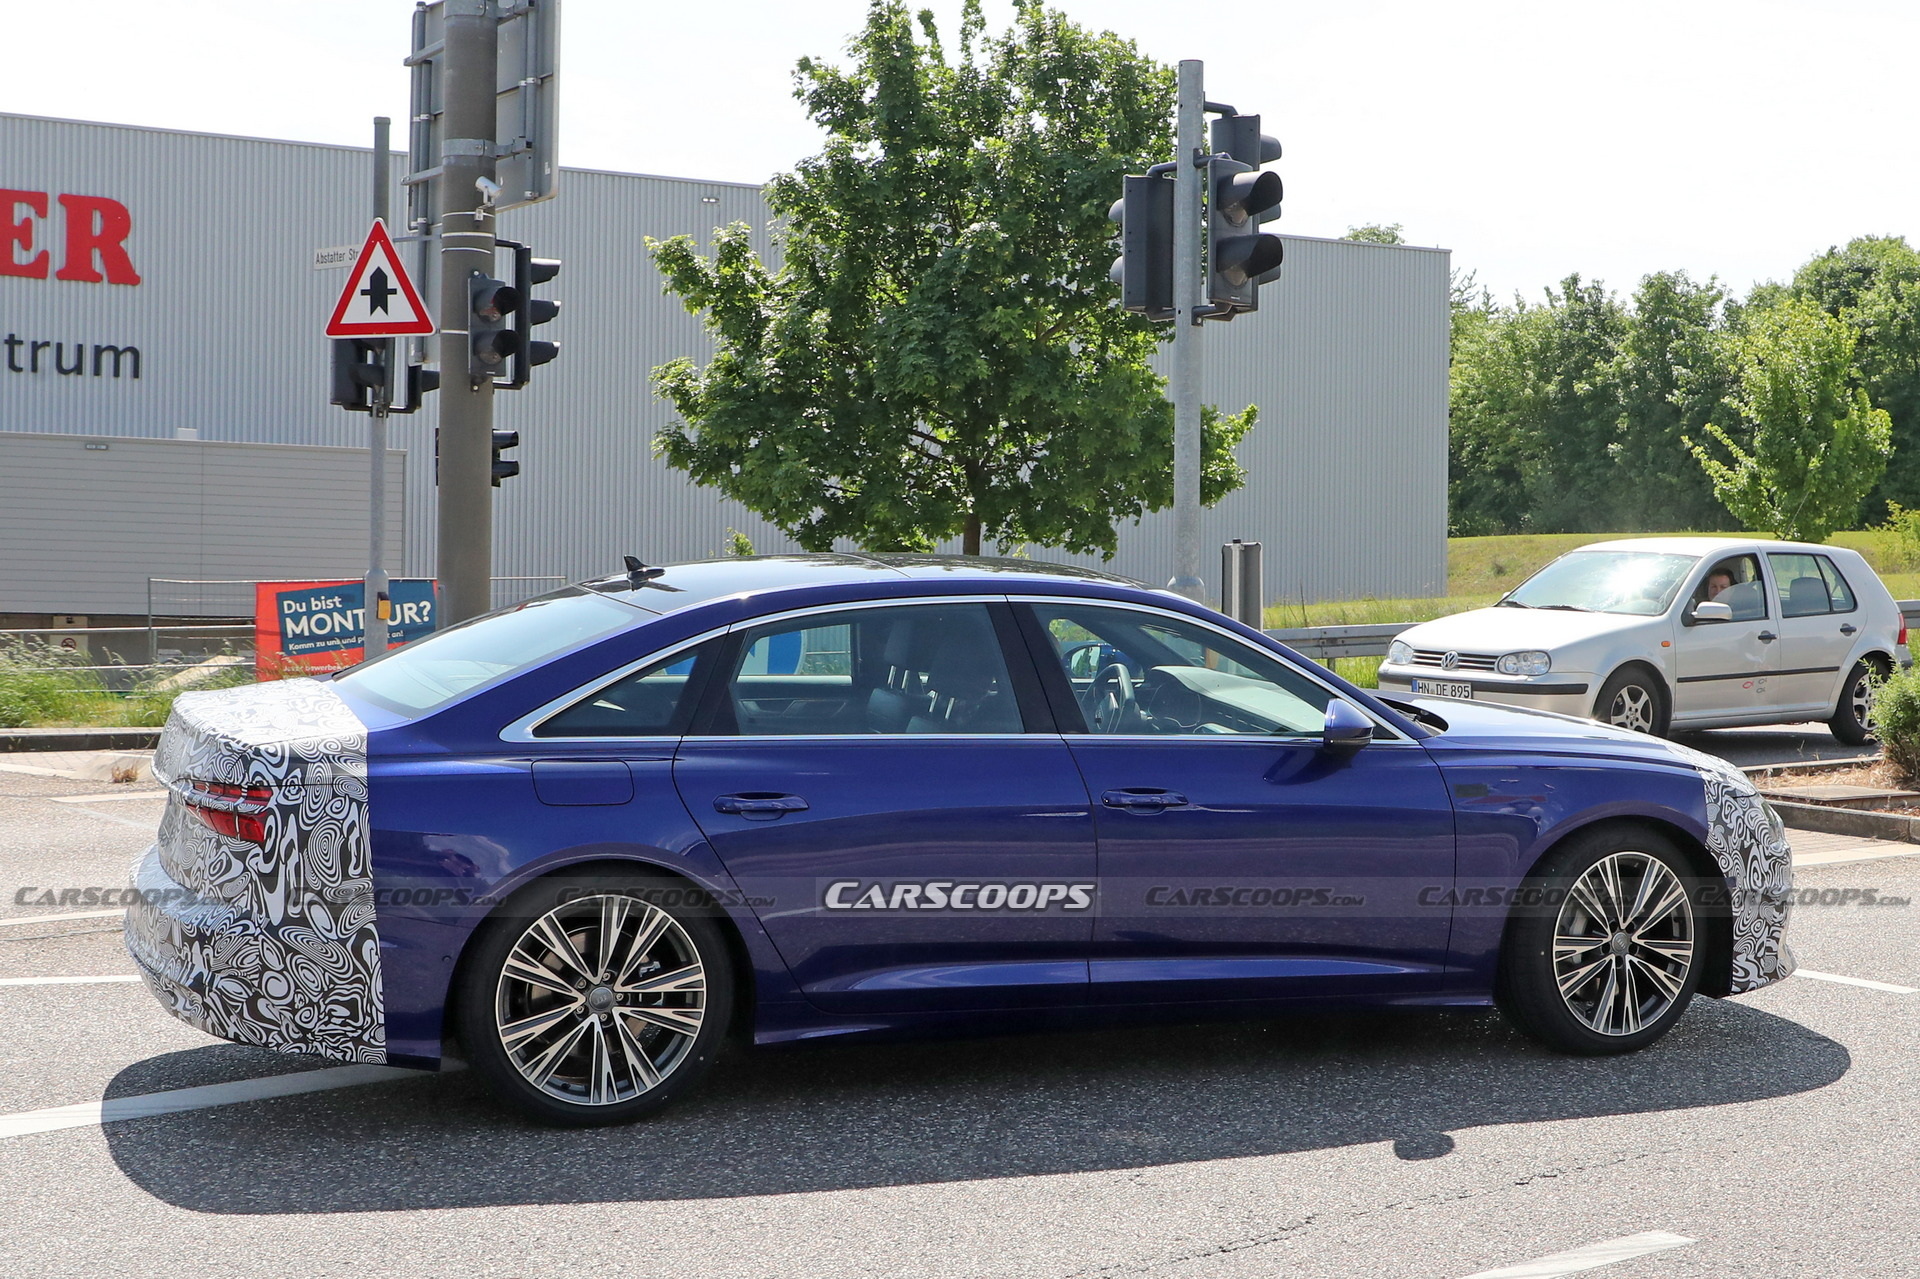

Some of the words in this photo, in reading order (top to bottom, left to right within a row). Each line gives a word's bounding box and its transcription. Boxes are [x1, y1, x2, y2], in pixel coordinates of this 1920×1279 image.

[316, 251, 346, 265] Abstatter
[4, 333, 140, 379] trum
[283, 600, 307, 614] Du
[311, 595, 342, 611] bist
[285, 600, 432, 638] MONTUR?
[288, 641, 315, 651] Komm
[316, 640, 326, 648] zu
[341, 635, 357, 645] und
[1417, 680, 1430, 695] HN
[1435, 683, 1449, 697] DE
[1450, 684, 1470, 699] 895
